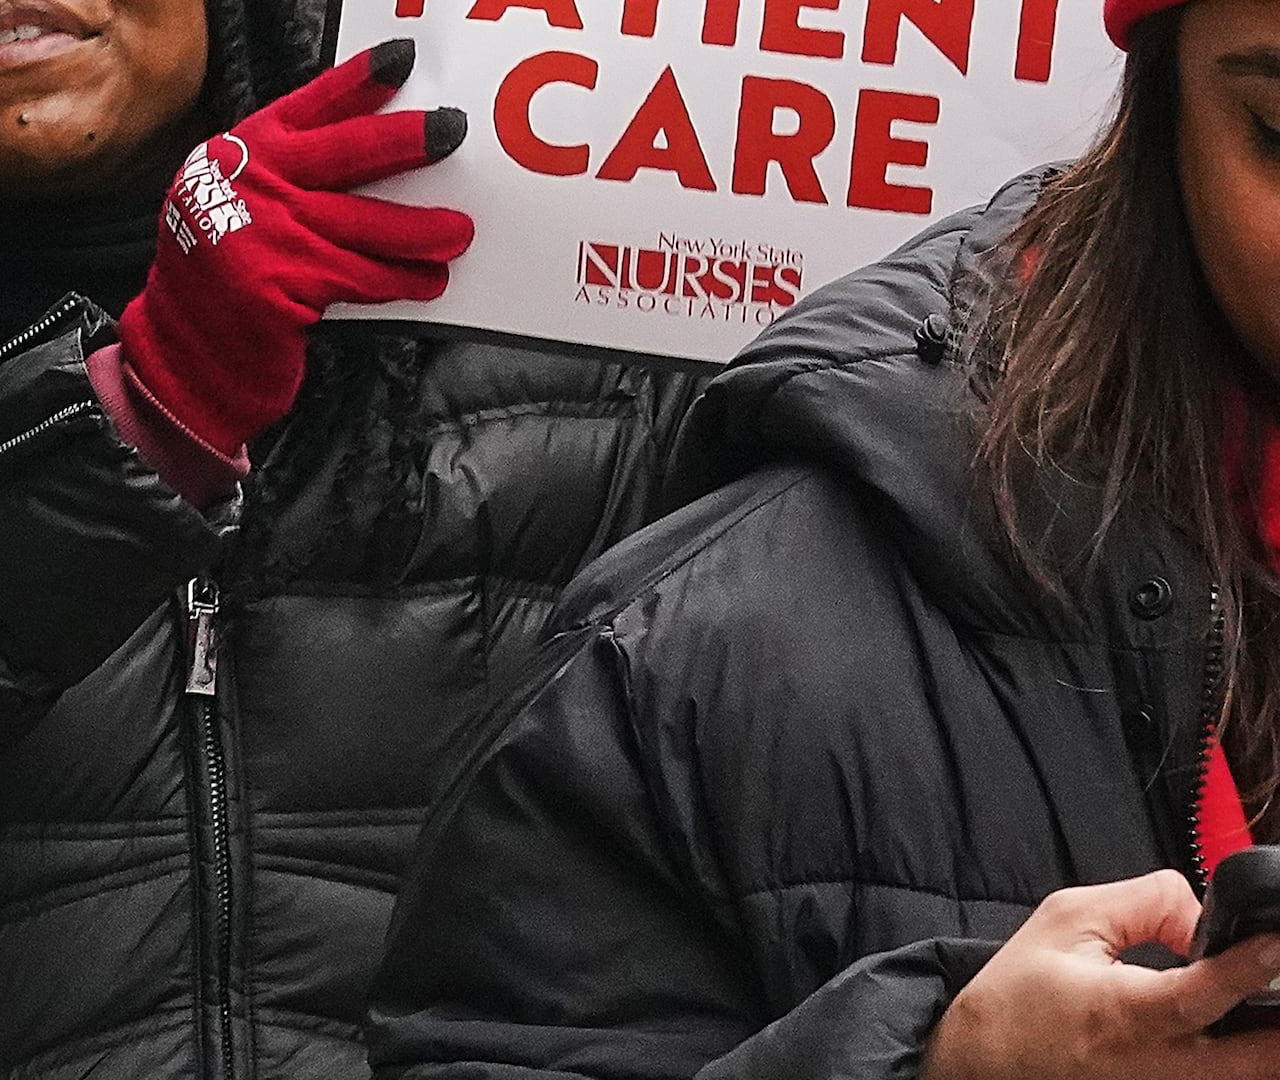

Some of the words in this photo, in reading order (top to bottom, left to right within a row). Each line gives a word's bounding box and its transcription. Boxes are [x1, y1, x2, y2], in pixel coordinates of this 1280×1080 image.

[492, 50, 942, 216] CARE
[577, 240, 804, 308] NURSES
[658, 231, 705, 255] New
[710, 237, 751, 260] York
[757, 243, 804, 268] State
[574, 285, 776, 326] ASSOCIATIO
